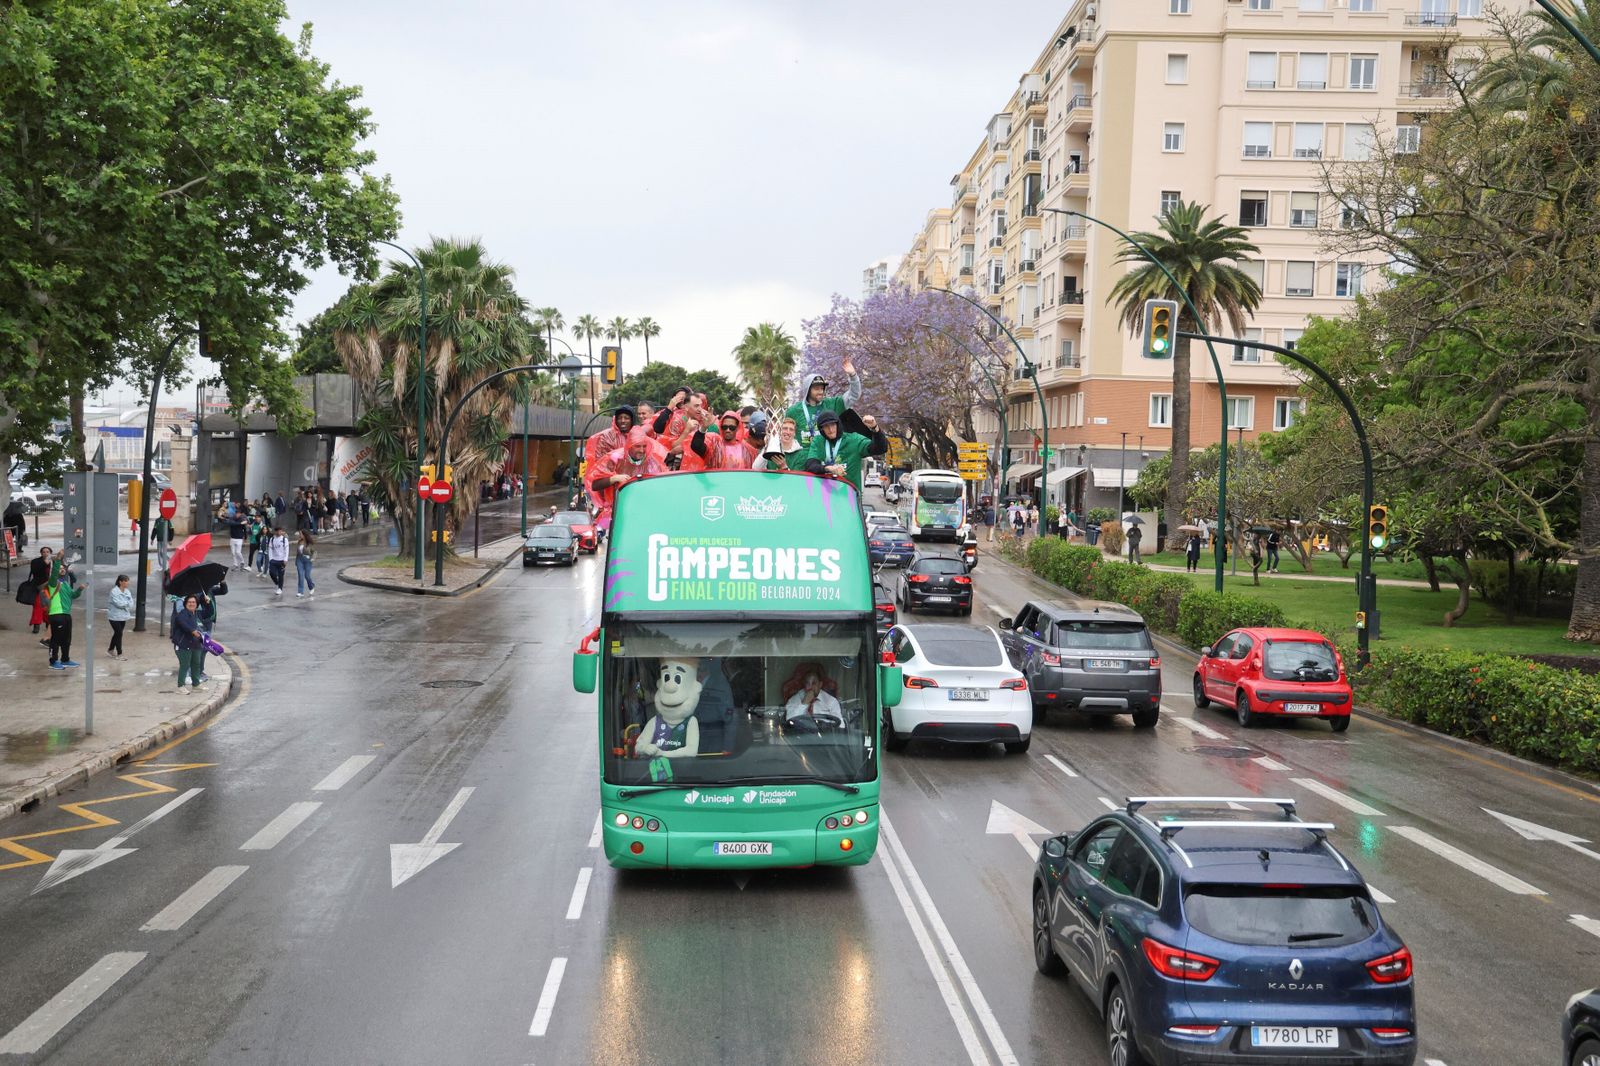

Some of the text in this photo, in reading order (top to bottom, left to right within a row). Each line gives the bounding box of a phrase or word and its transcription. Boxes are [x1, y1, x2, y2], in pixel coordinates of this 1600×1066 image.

[647, 533, 841, 602] CAMPEONES
[671, 581, 841, 601] FINAL FOUR BELGRADO 2024
[867, 747, 874, 759] 7
[701, 794, 735, 804] Unicaja
[759, 790, 797, 798] Fundación
[759, 797, 787, 805] Unicaja
[722, 843, 769, 854] 8400 GXK
[1267, 983, 1324, 991] KADJAR
[1263, 1028, 1334, 1044] 1780 LRF
